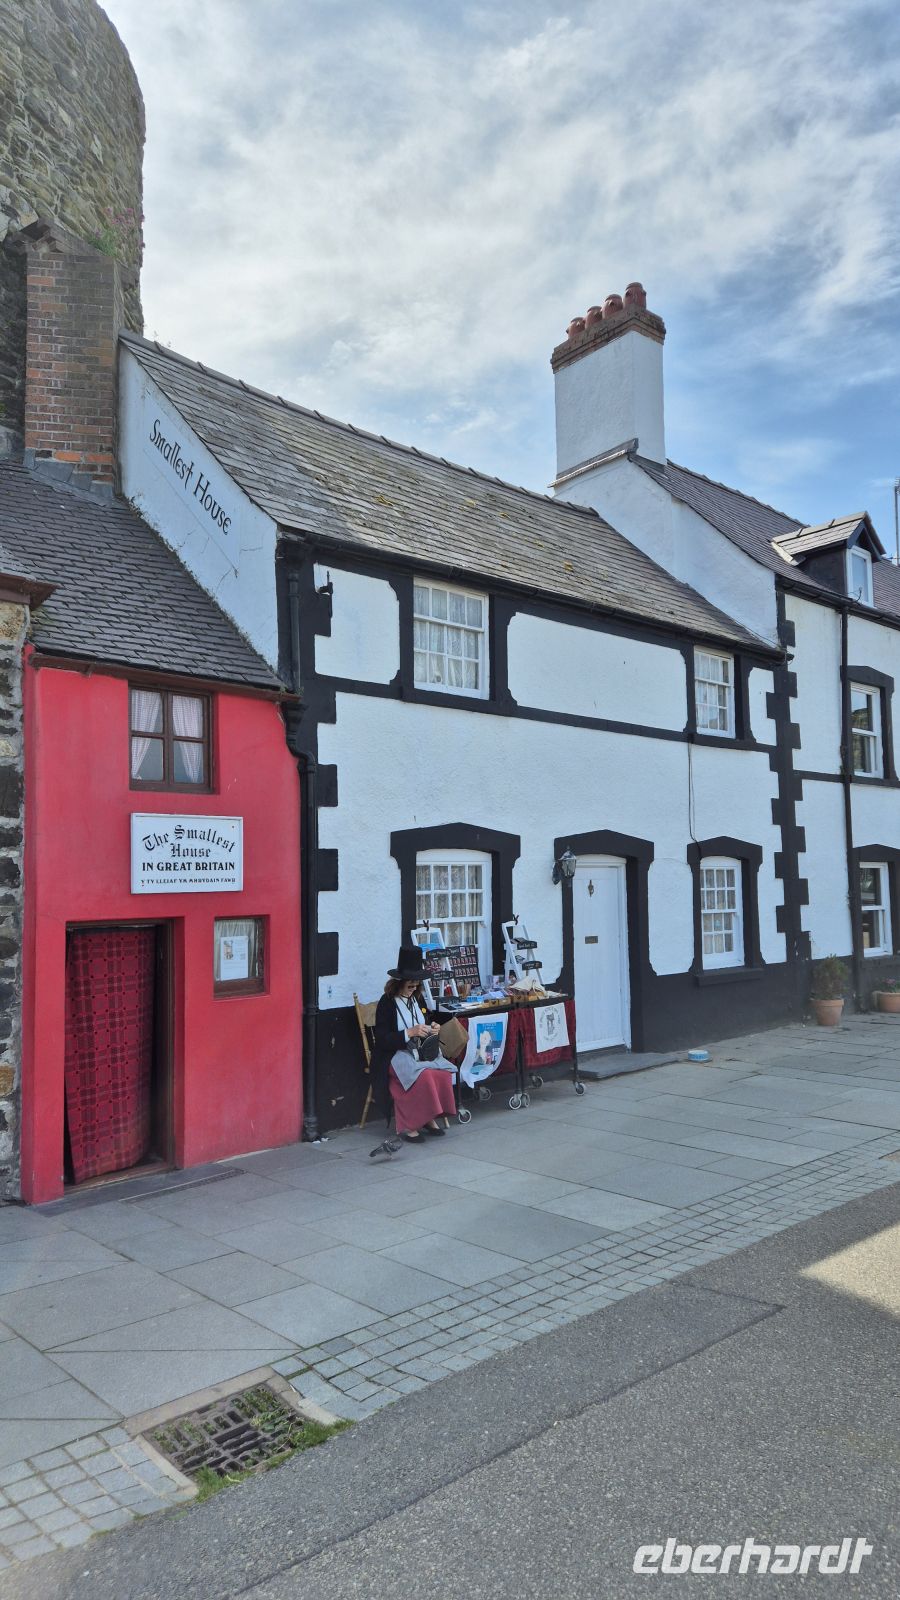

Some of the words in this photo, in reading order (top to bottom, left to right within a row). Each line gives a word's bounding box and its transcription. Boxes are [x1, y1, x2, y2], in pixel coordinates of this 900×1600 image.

[149, 419, 194, 490] Smallest
[193, 472, 231, 535] House
[142, 832, 169, 851] The
[174, 824, 236, 853] Smallest
[170, 842, 211, 858] House
[142, 862, 154, 871] IN
[156, 861, 192, 871] GREAT
[195, 861, 235, 871] BRITAIN
